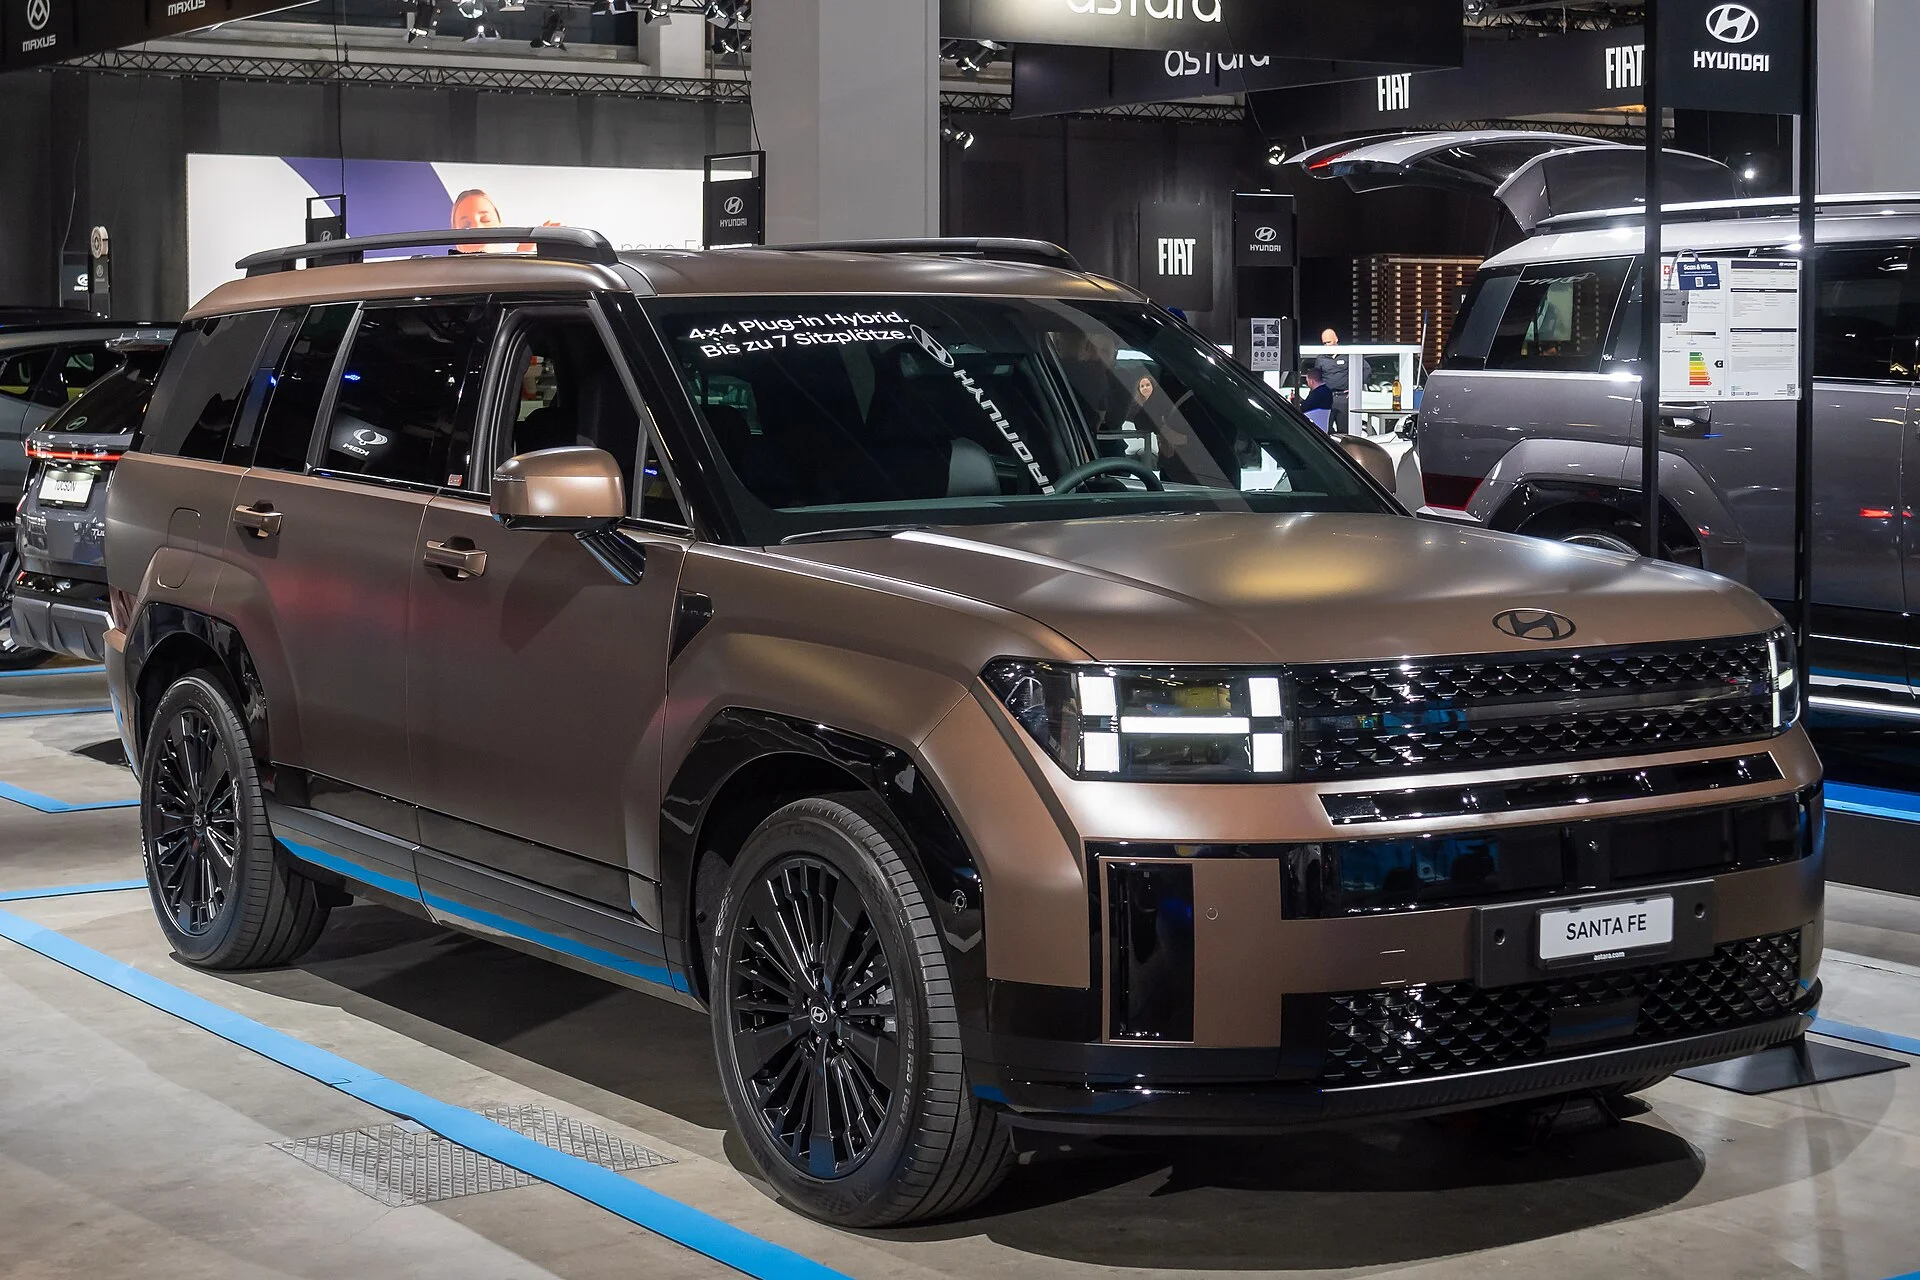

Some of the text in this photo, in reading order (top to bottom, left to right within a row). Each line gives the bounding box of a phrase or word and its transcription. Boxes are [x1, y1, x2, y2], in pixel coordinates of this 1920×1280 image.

[22, 33, 57, 53] MAXUS
[1604, 44, 1645, 90] FIAT
[1693, 50, 1770, 72] HYUNDAI
[1376, 72, 1412, 112] FIAT
[719, 217, 748, 228] HYUNDAI
[1157, 238, 1196, 276] FIAT
[1249, 244, 1282, 252] HYUNDAI
[738, 314, 825, 333] Plug-in
[825, 311, 910, 327] Hybrid.
[700, 328, 913, 358] Bis zu 7 Sitzplätze.
[1566, 913, 1647, 941] SANTA FE
[1593, 950, 1626, 961] astara.com
